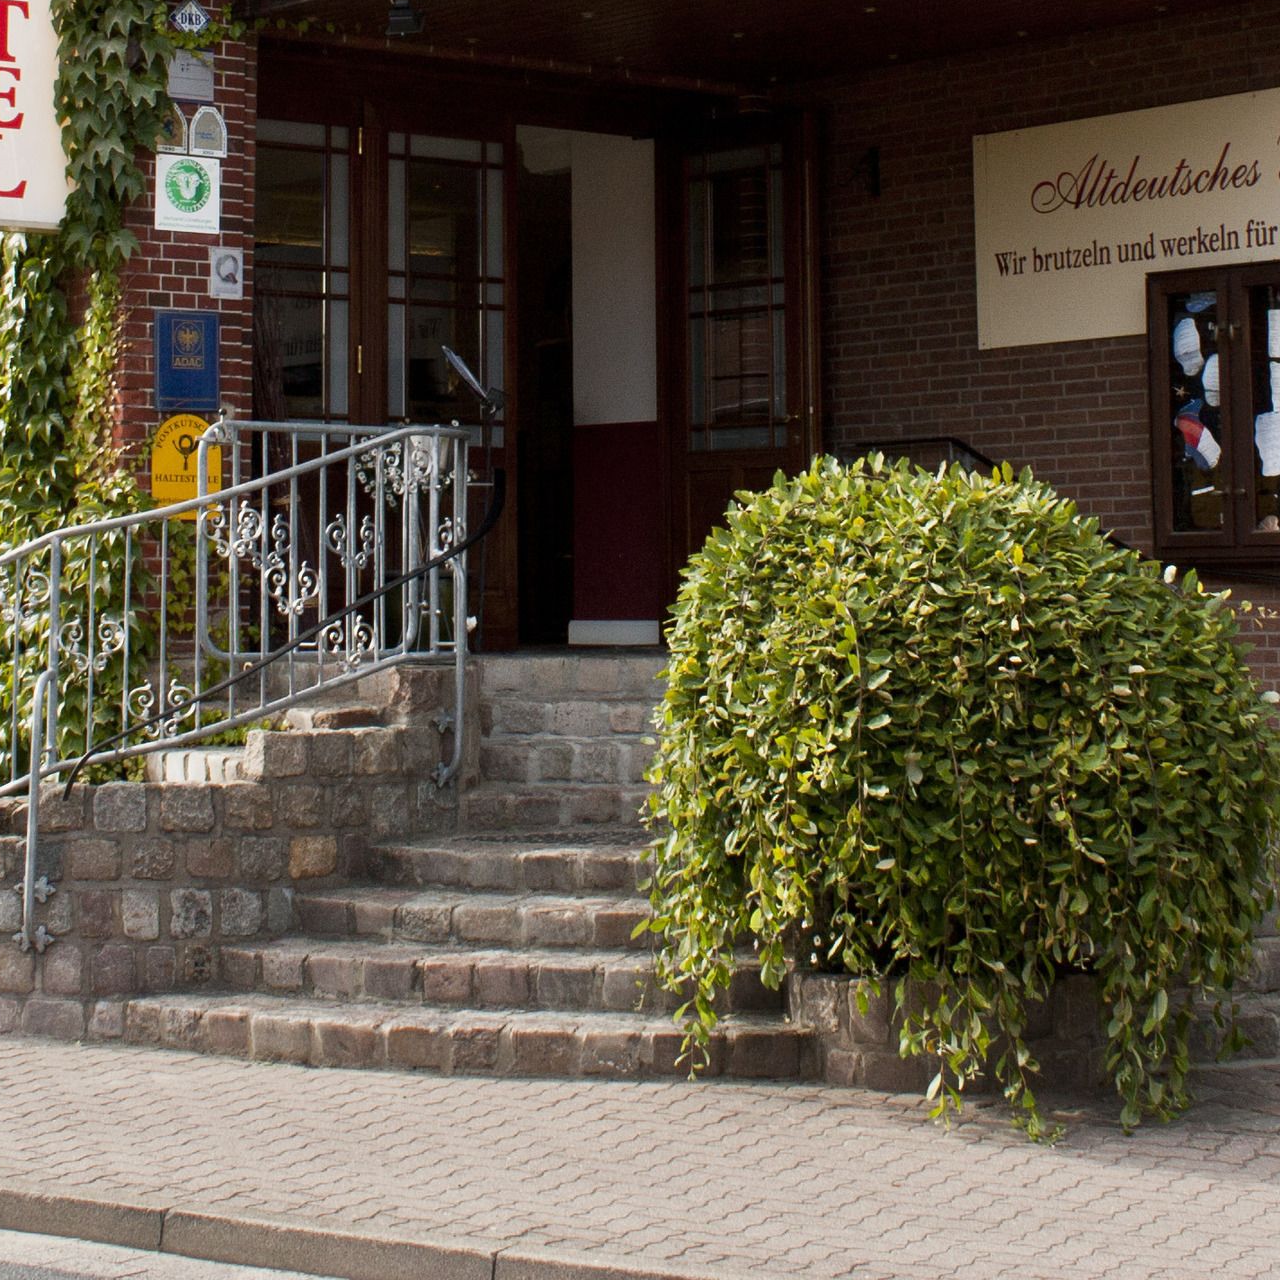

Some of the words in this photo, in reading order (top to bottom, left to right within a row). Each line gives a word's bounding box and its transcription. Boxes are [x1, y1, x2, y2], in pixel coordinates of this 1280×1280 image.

[180, 12, 201, 26] DKB
[1031, 142, 1261, 214] Altdeutsches
[995, 250, 1027, 277] Wir
[1032, 239, 1112, 273] brutzeln
[1117, 232, 1156, 263] und
[1160, 224, 1241, 258] werkeln
[1246, 219, 1278, 248] für
[173, 356, 204, 368] ADAC
[155, 474, 219, 484] HALTESTLE
